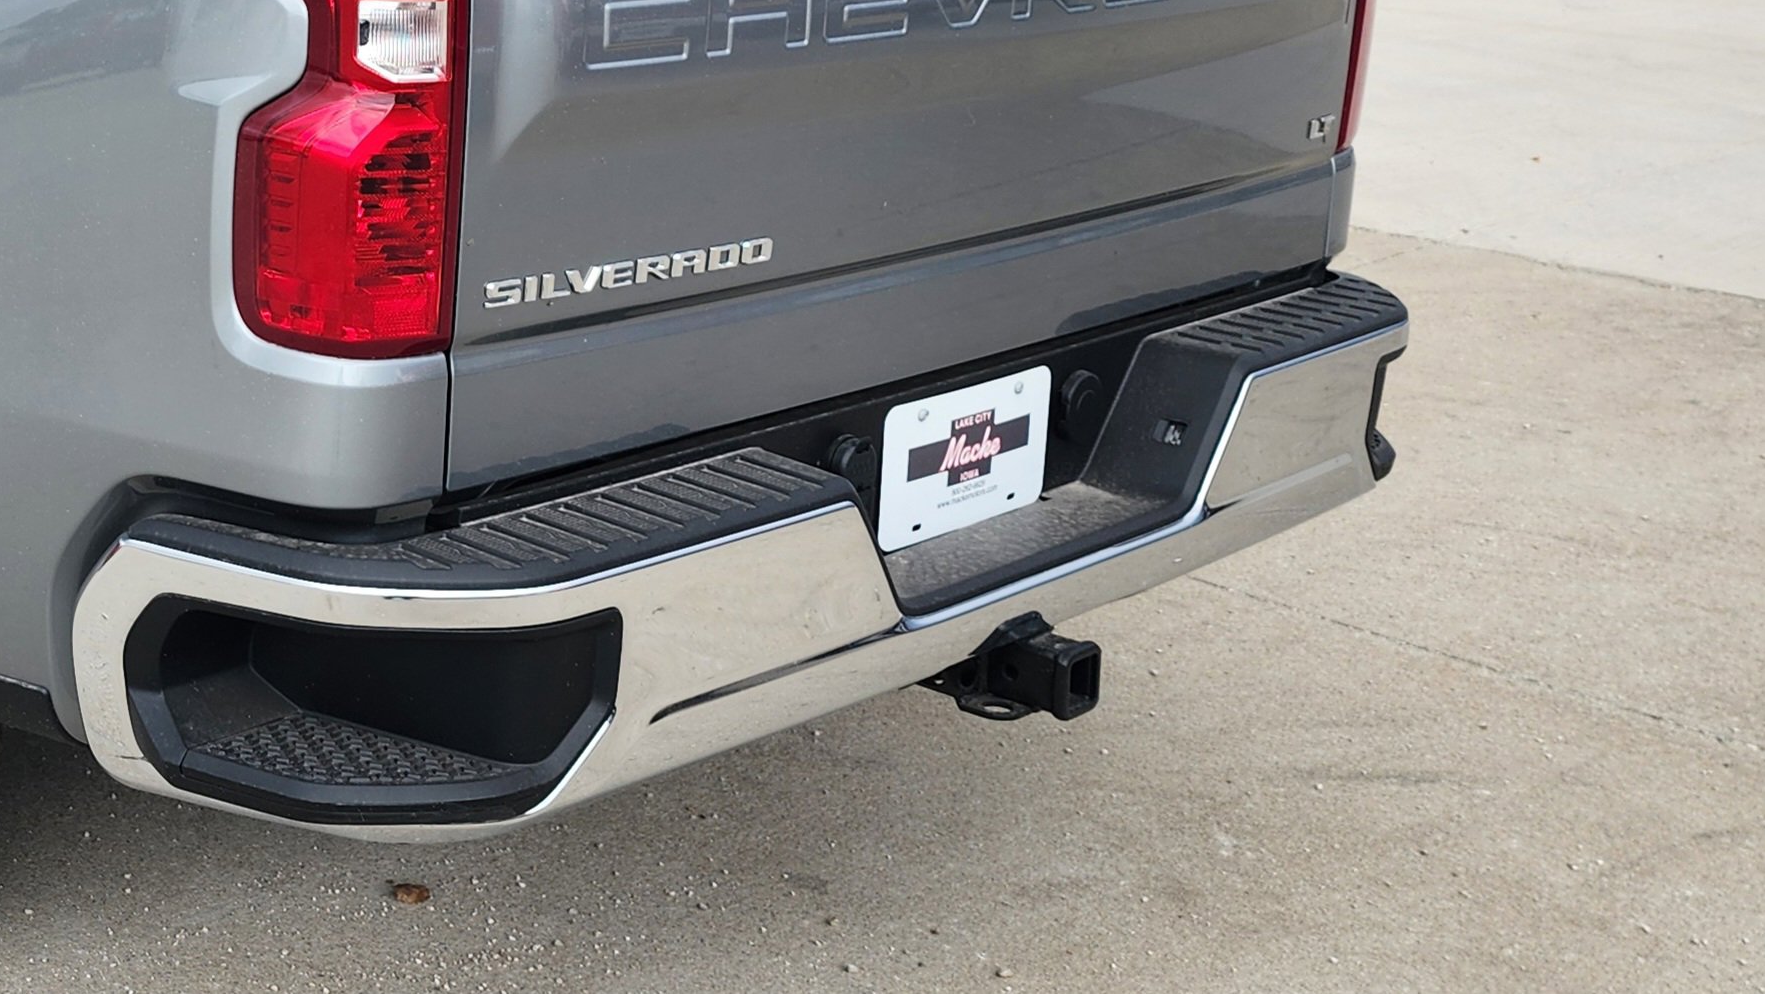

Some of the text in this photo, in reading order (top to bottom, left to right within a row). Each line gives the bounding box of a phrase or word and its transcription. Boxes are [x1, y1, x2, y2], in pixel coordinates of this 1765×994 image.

[1306, 113, 1336, 143] LT
[483, 236, 774, 309] SILVERADO
[954, 410, 993, 430] LAKE CITY
[937, 425, 1002, 474] Macke
